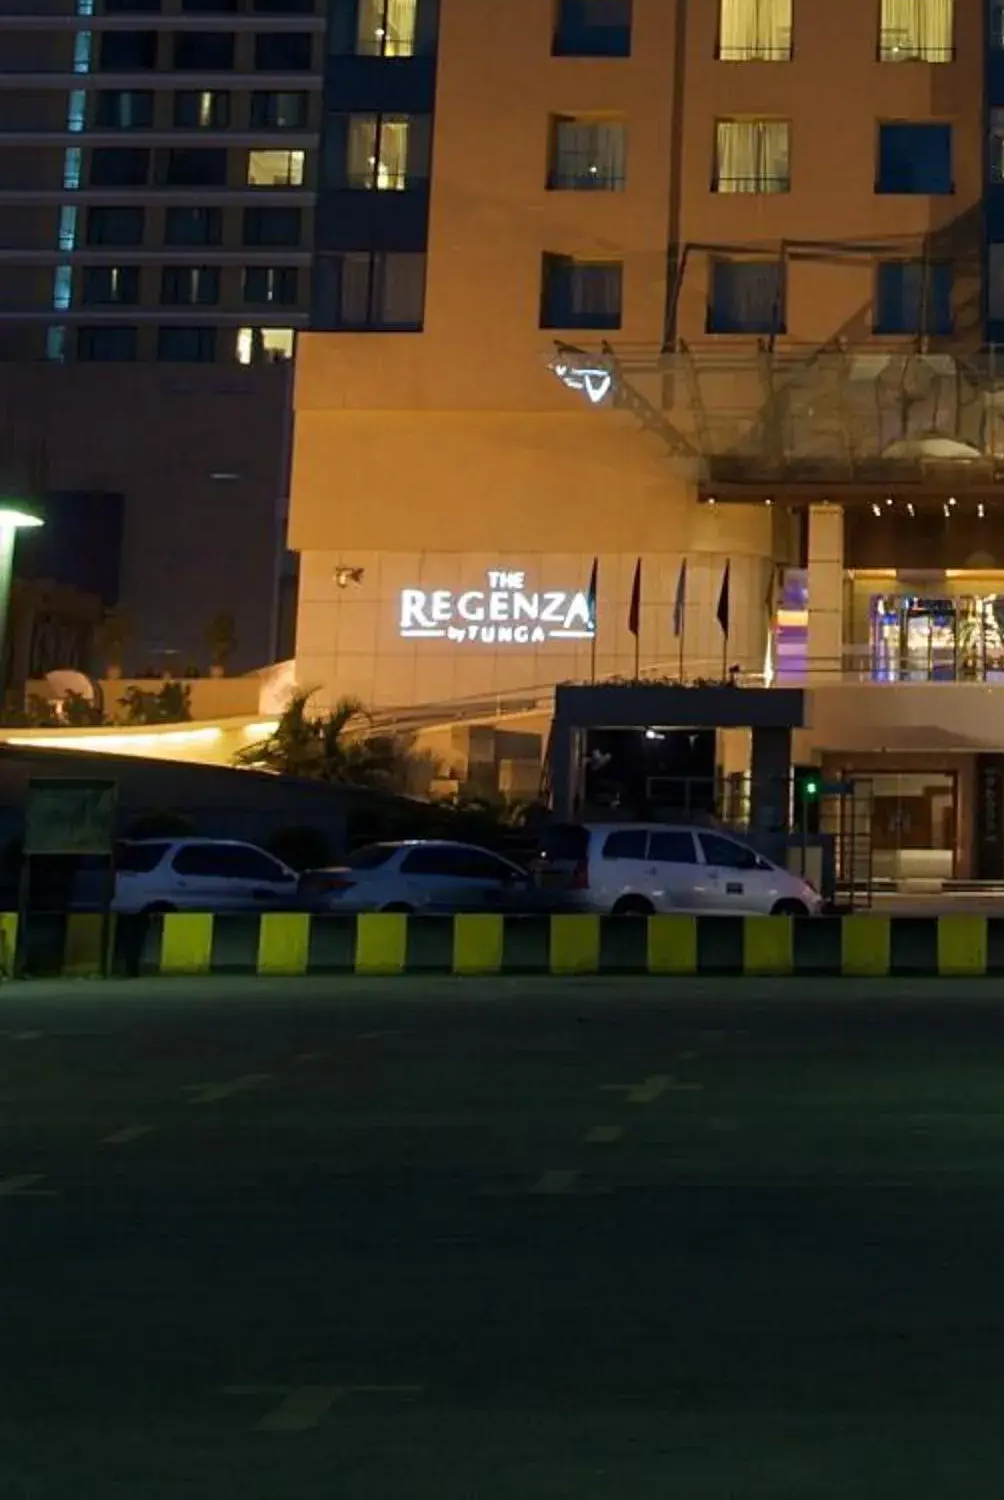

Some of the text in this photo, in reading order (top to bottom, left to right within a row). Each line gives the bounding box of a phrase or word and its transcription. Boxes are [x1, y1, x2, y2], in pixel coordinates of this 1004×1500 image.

[487, 570, 525, 589] THE
[400, 588, 595, 629] REGENZA
[467, 625, 545, 643] TUNGA
